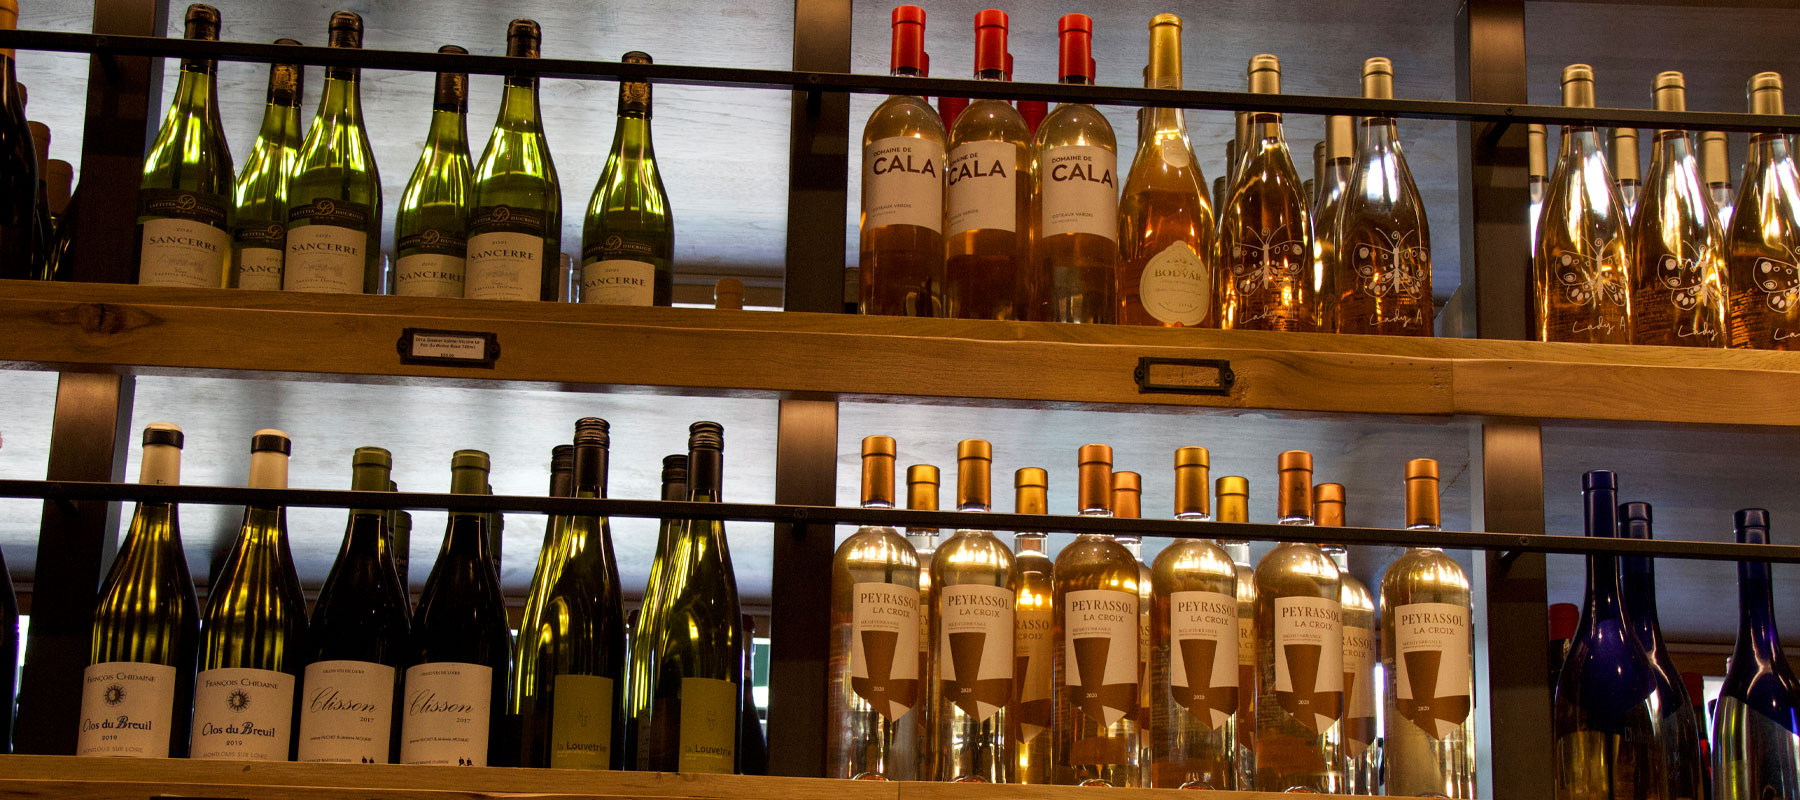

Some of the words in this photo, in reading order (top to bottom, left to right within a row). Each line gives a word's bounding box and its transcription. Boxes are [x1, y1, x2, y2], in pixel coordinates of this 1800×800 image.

[873, 147, 901, 157] DOMAINE
[1051, 155, 1081, 163] DOMAINE
[873, 155, 936, 178] CALA
[949, 160, 1006, 186] CALA
[1051, 163, 1113, 188] CALA
[149, 236, 218, 252] SANCERRE
[291, 242, 359, 257] SANCERRE
[470, 249, 535, 262] SANCERRE
[399, 271, 464, 283] SANCERRE
[584, 276, 647, 289] SANCERRE
[1239, 305, 1278, 325] Lady
[1286, 305, 1294, 319] A
[1369, 308, 1411, 326] Lady
[1415, 308, 1423, 325] A
[1572, 316, 1615, 335] Lady
[1619, 316, 1626, 332] A
[1677, 321, 1718, 340] Lady
[860, 593, 918, 610] PEYRASSOL
[948, 595, 1009, 610] PEYRASSOL
[1072, 599, 1133, 615] PEYRASSOL
[886, 607, 910, 618] CROIX
[959, 608, 971, 616] LA
[973, 608, 1000, 618] CROIX
[1178, 601, 1236, 618] PEYRASSOL
[1282, 606, 1340, 622] PEYRASSOL
[1097, 614, 1124, 623] CROIX
[1204, 615, 1229, 625] CROIX
[1309, 620, 1333, 631] CROIX
[1402, 613, 1464, 627] PEYRASSOL
[1413, 627, 1426, 635] LA
[1428, 627, 1455, 635] CROIX
[116, 672, 156, 683] CHIDAINE
[205, 679, 238, 688] FRANÇOIS
[240, 678, 279, 690] CHIDAINE
[310, 686, 377, 713] Clisson
[409, 689, 474, 716] Clisson
[83, 718, 99, 732] Clos
[102, 719, 114, 729] du
[116, 715, 152, 731] Breuil
[202, 722, 223, 736] Clos
[225, 724, 239, 735] du
[240, 721, 275, 738] Breuil
